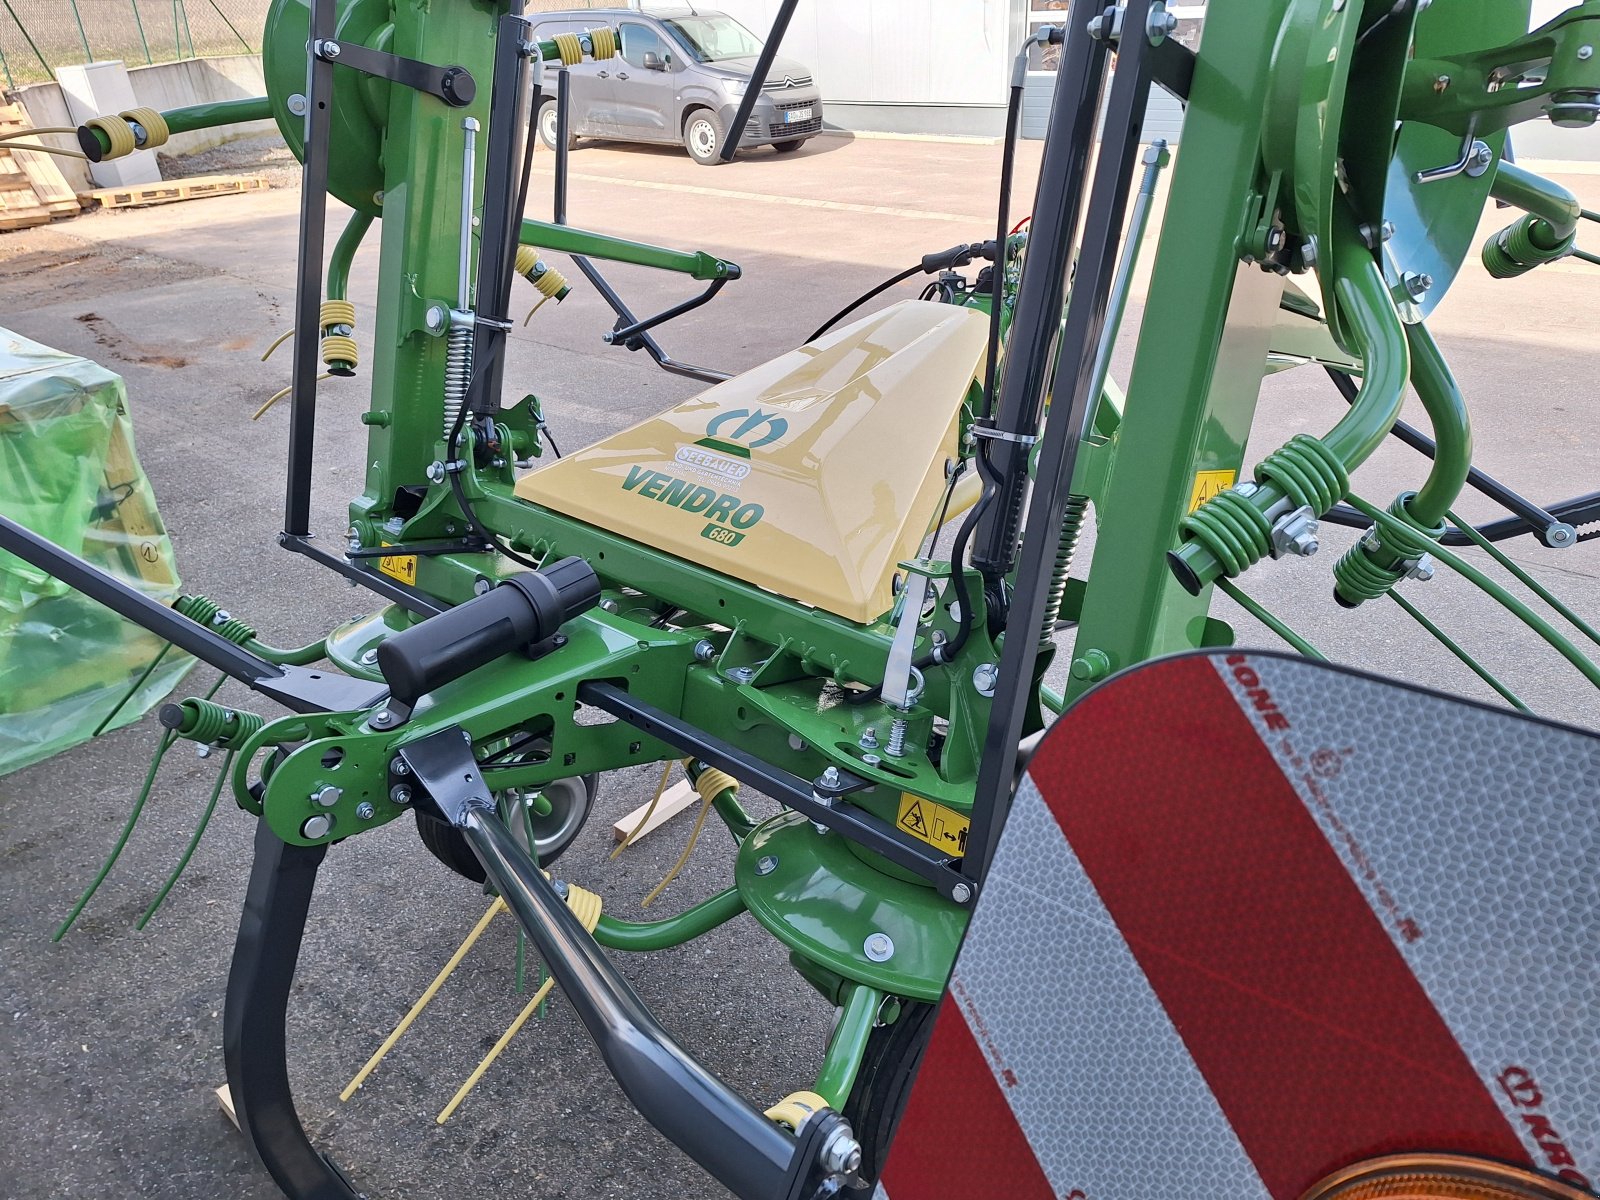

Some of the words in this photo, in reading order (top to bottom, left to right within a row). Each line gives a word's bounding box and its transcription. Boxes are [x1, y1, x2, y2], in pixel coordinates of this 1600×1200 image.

[677, 446, 747, 477] SEEBAUER
[621, 464, 765, 530] VENDRO
[708, 528, 736, 544] 680
